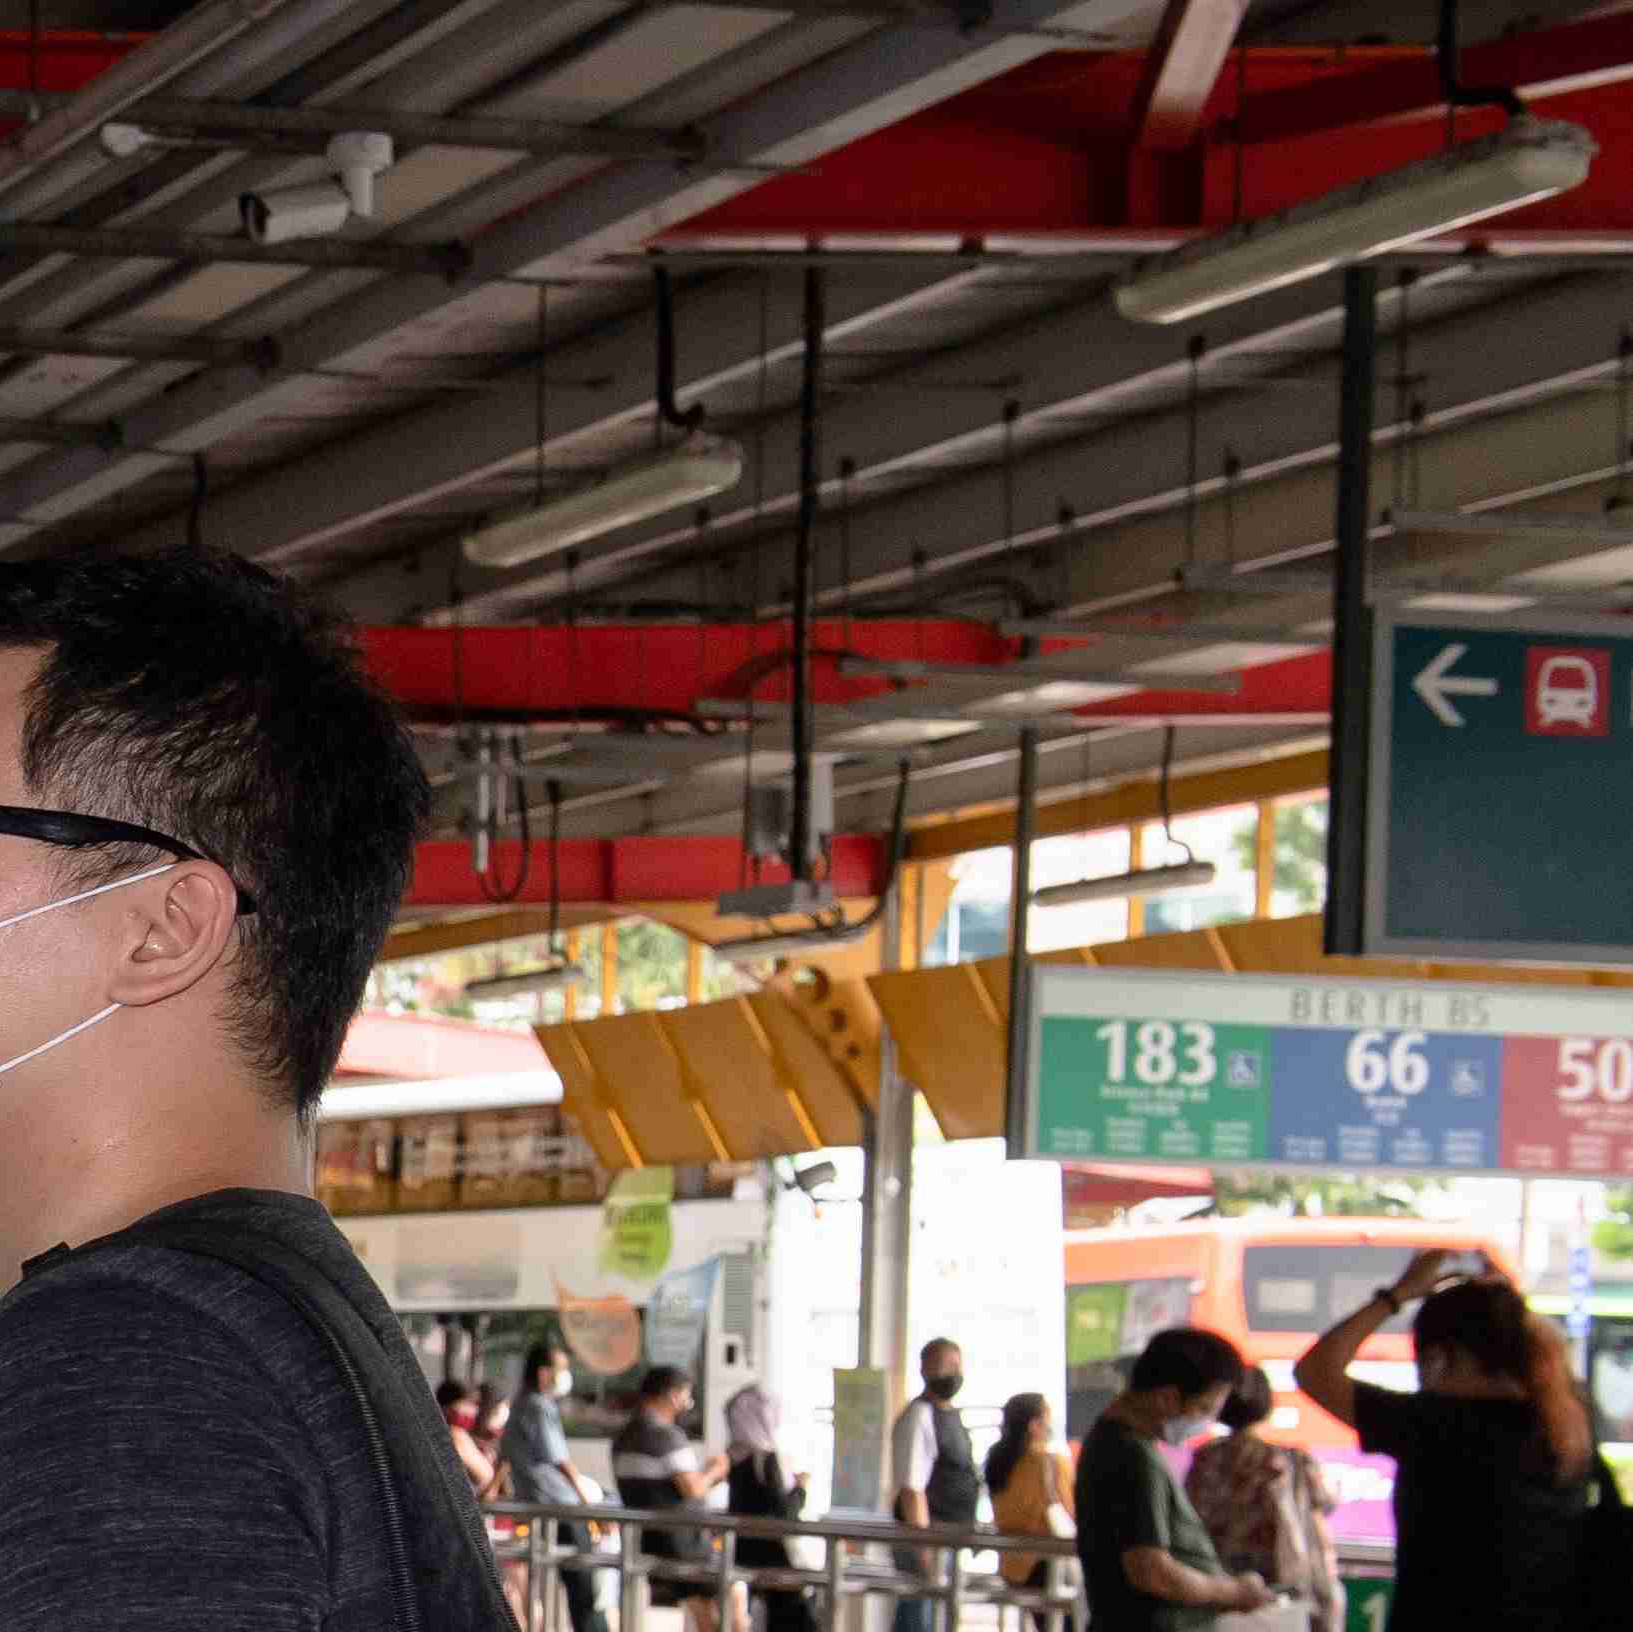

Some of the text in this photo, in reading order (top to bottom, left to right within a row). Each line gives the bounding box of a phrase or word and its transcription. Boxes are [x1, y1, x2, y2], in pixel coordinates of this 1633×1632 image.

[1291, 988, 1423, 1026] BERTH
[1095, 1020, 1217, 1086] 183
[1345, 1030, 1430, 1096] 66
